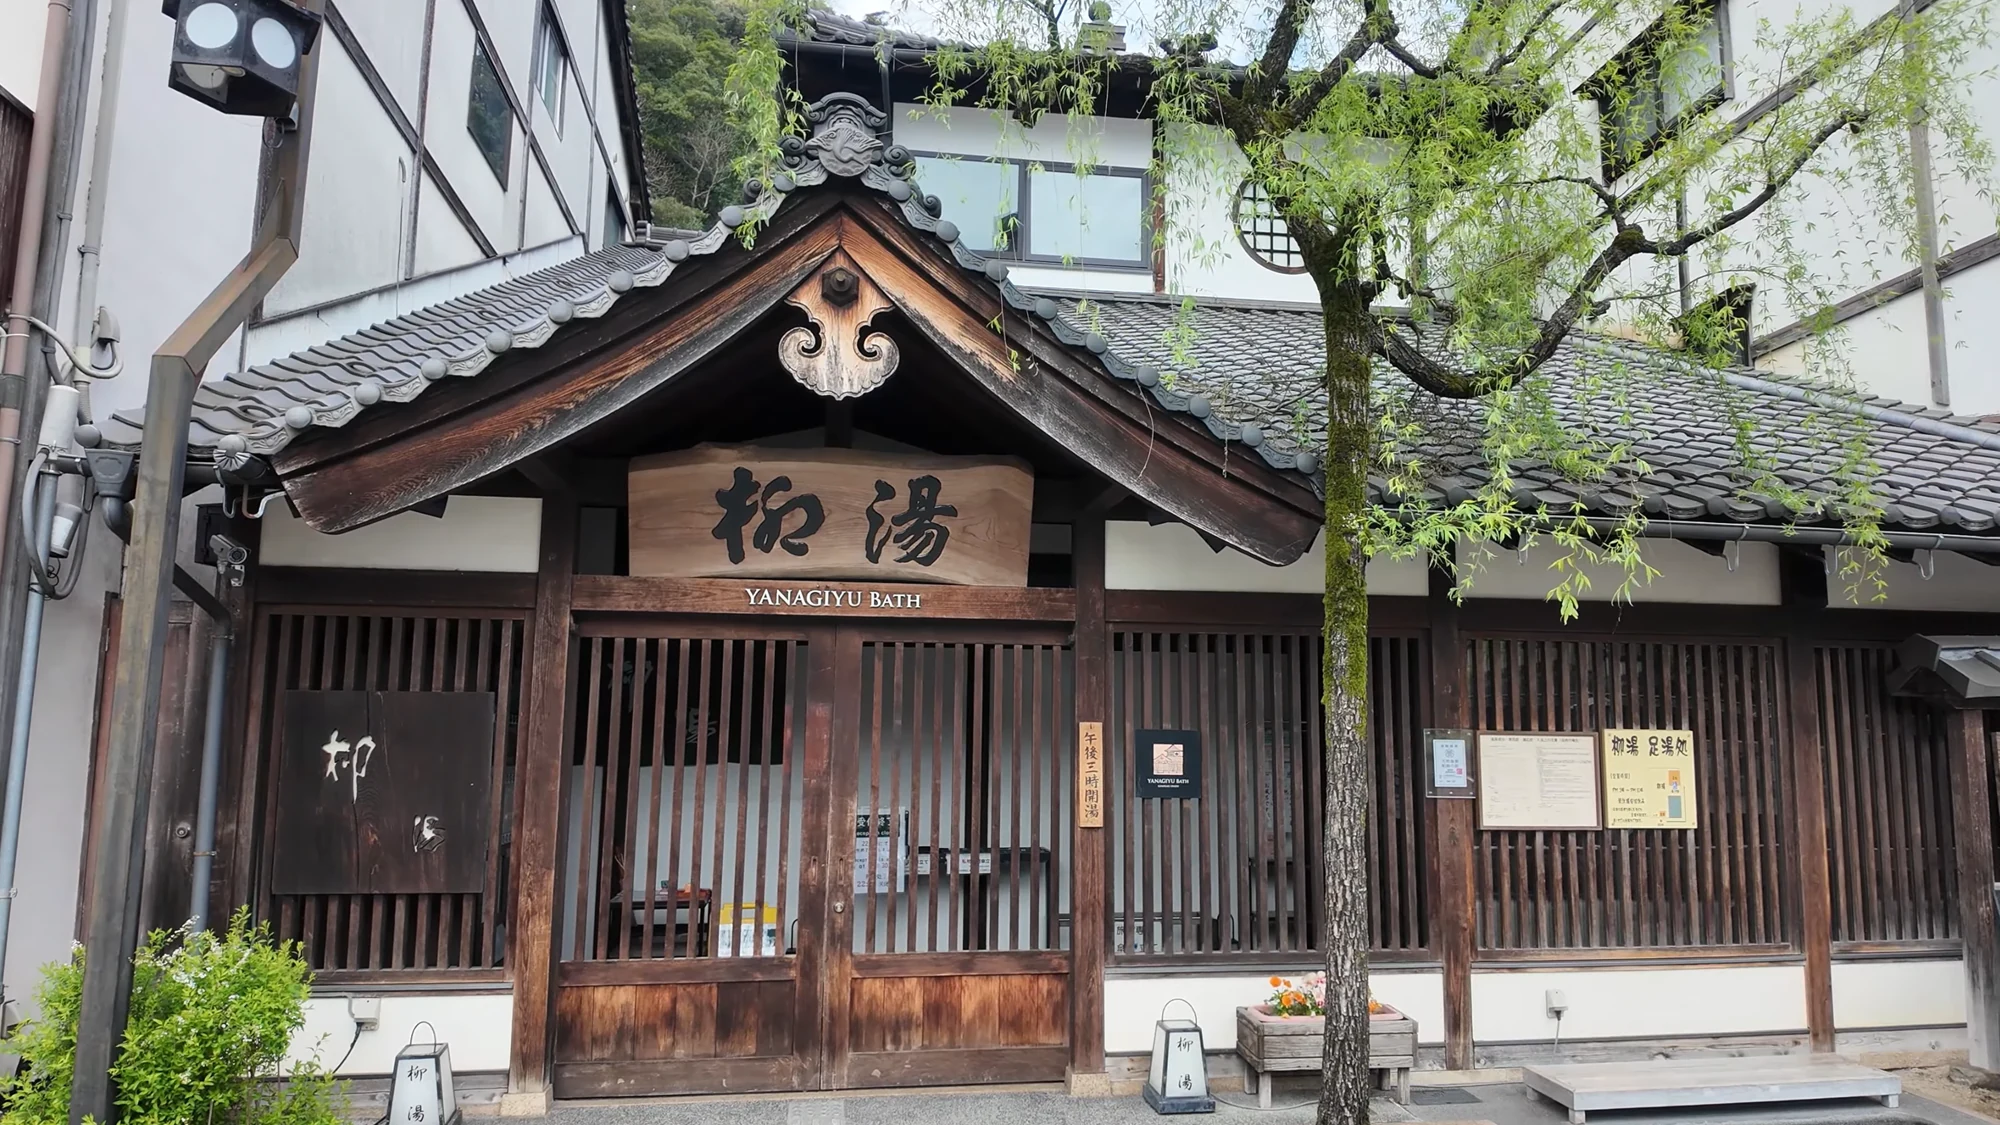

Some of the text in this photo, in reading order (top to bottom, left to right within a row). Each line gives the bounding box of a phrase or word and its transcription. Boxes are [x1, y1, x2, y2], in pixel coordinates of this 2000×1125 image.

[712, 466, 958, 567] 柳湯
[745, 588, 921, 609] YANAGIYU BATH
[1611, 735, 1688, 757] 柳湯 足湯処
[1084, 732, 1099, 819] 午後三時開湯
[1176, 1036, 1194, 1091] 柳湯
[407, 1065, 428, 1123] 柳湯
